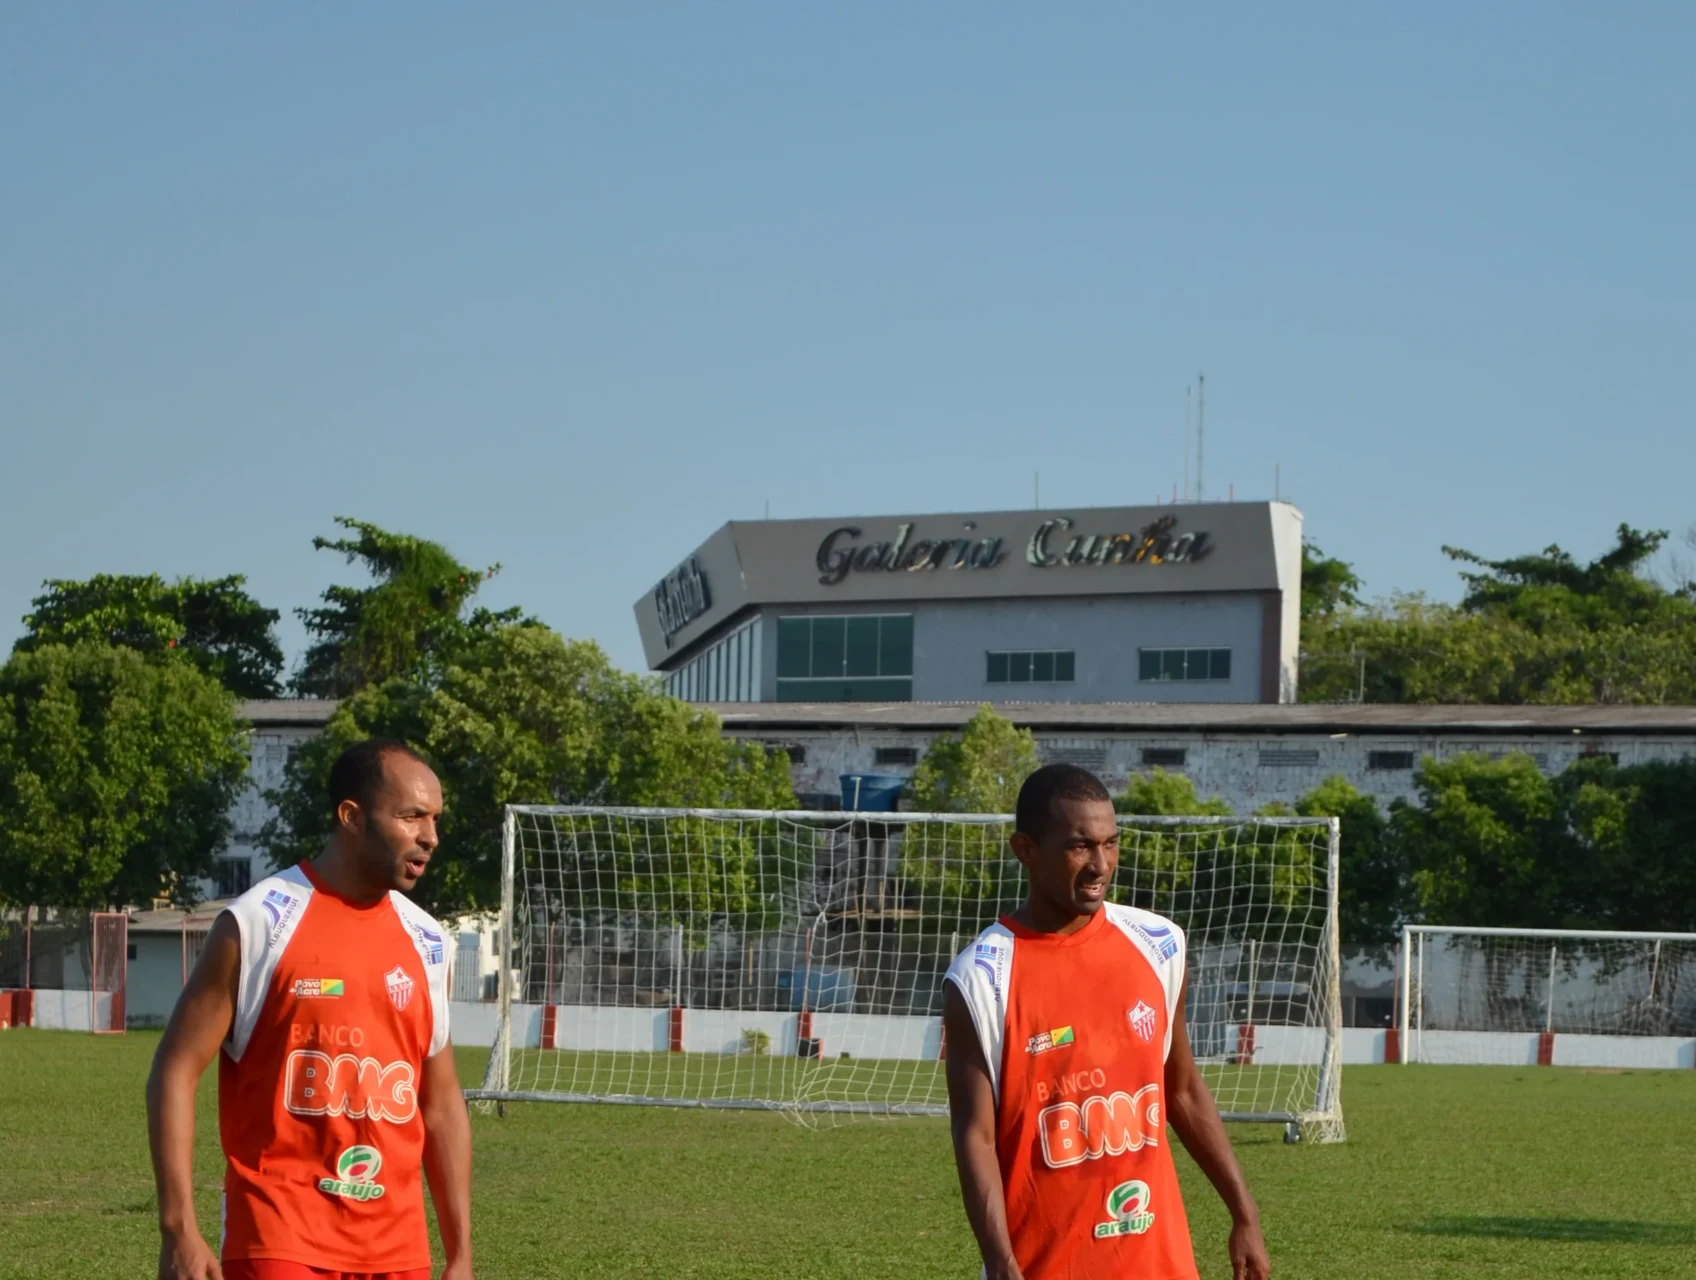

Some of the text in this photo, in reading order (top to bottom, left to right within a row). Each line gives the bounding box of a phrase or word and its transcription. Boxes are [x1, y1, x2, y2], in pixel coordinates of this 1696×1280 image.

[815, 515, 1214, 585] Galeria Cunha
[1122, 918, 1165, 965] ALBUQUERQUE
[290, 1023, 364, 1048] BANCO
[284, 1050, 417, 1124] BMG
[1037, 1068, 1106, 1102] BANCO
[319, 1179, 384, 1201] araujo
[1096, 1213, 1154, 1238] araujo
